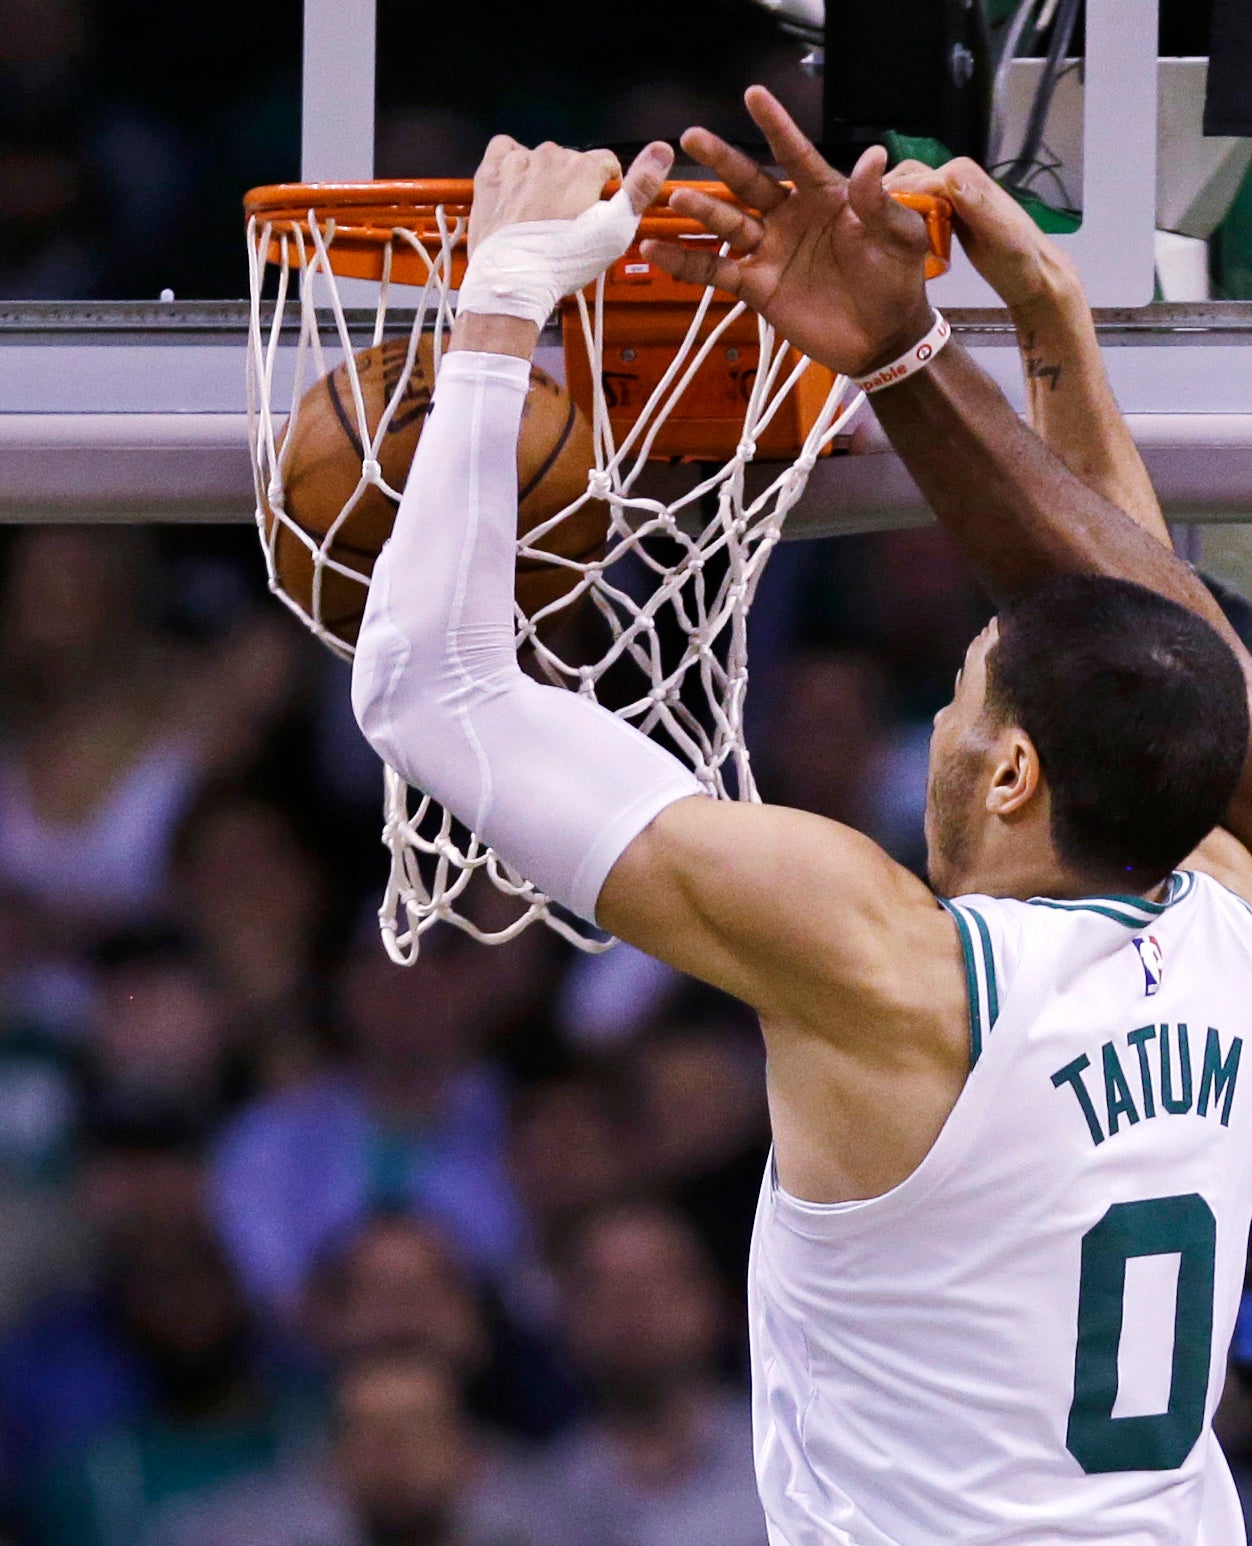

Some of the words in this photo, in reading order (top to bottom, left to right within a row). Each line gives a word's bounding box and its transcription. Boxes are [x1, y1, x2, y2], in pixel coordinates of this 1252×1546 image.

[860, 364, 907, 392] pable
[1050, 1022, 1243, 1147] TATUM
[1065, 1193, 1217, 1474] 0
